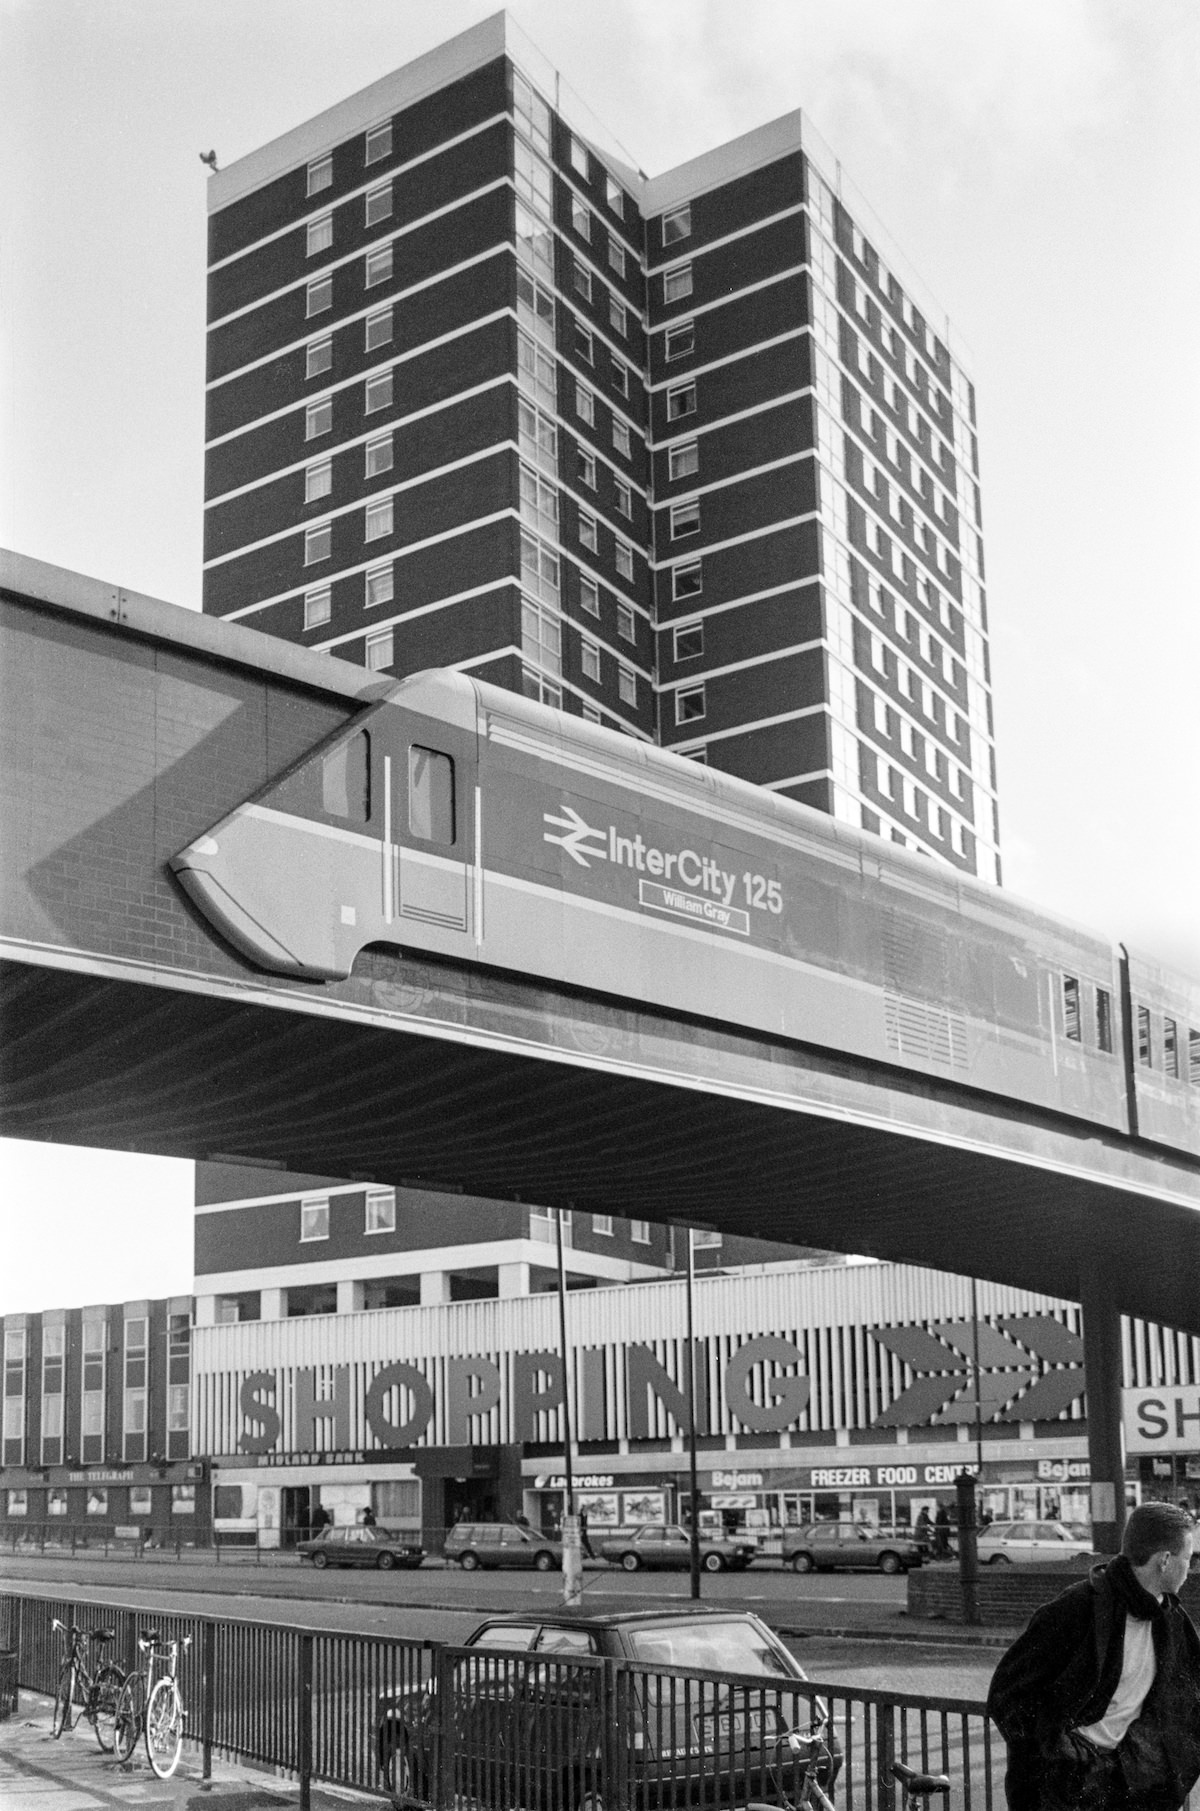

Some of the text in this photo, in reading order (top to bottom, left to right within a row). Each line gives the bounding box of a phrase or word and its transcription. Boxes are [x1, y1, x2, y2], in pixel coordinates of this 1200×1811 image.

[609, 825, 784, 915] InterCity 125
[663, 889, 731, 926] William Gray
[238, 1334, 811, 1455] SHOPPING
[258, 1451, 365, 1467] MIDLAND BANK
[712, 1470, 763, 1490] Bejam
[811, 1468, 871, 1487] FREEZER
[877, 1466, 917, 1485] FOOD
